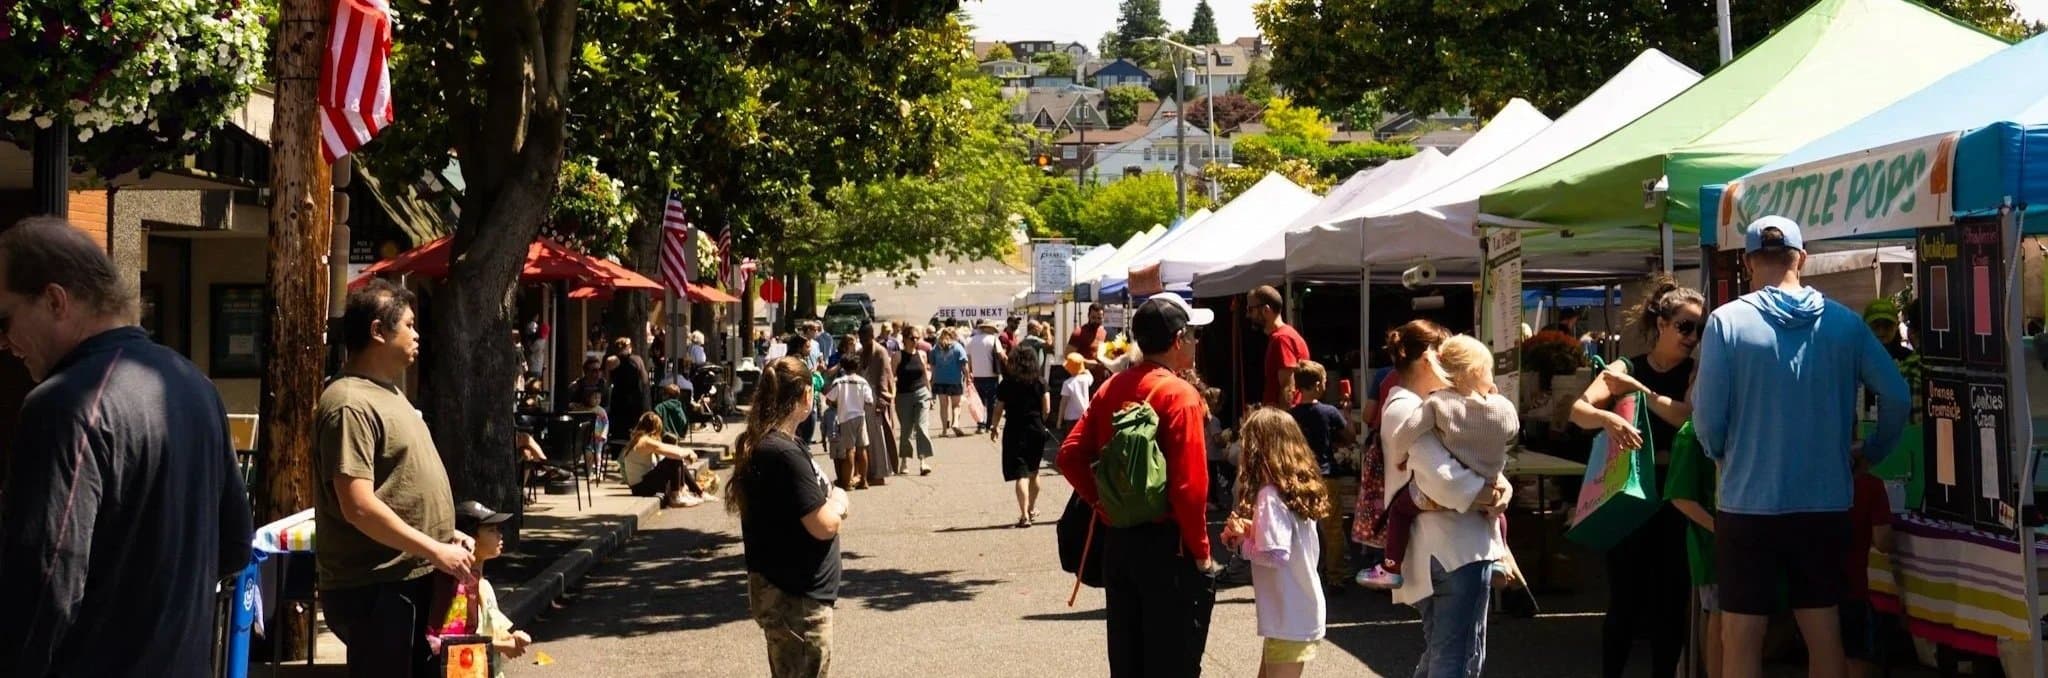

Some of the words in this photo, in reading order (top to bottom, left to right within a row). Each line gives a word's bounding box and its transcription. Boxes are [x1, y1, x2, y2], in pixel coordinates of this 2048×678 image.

[1737, 168, 1844, 234] SEATTLE
[1845, 149, 1927, 221] POPS
[939, 308, 957, 318] SEE
[960, 308, 977, 317] YOU
[980, 307, 1002, 317] NEXT
[1970, 386, 2003, 409] Cookies
